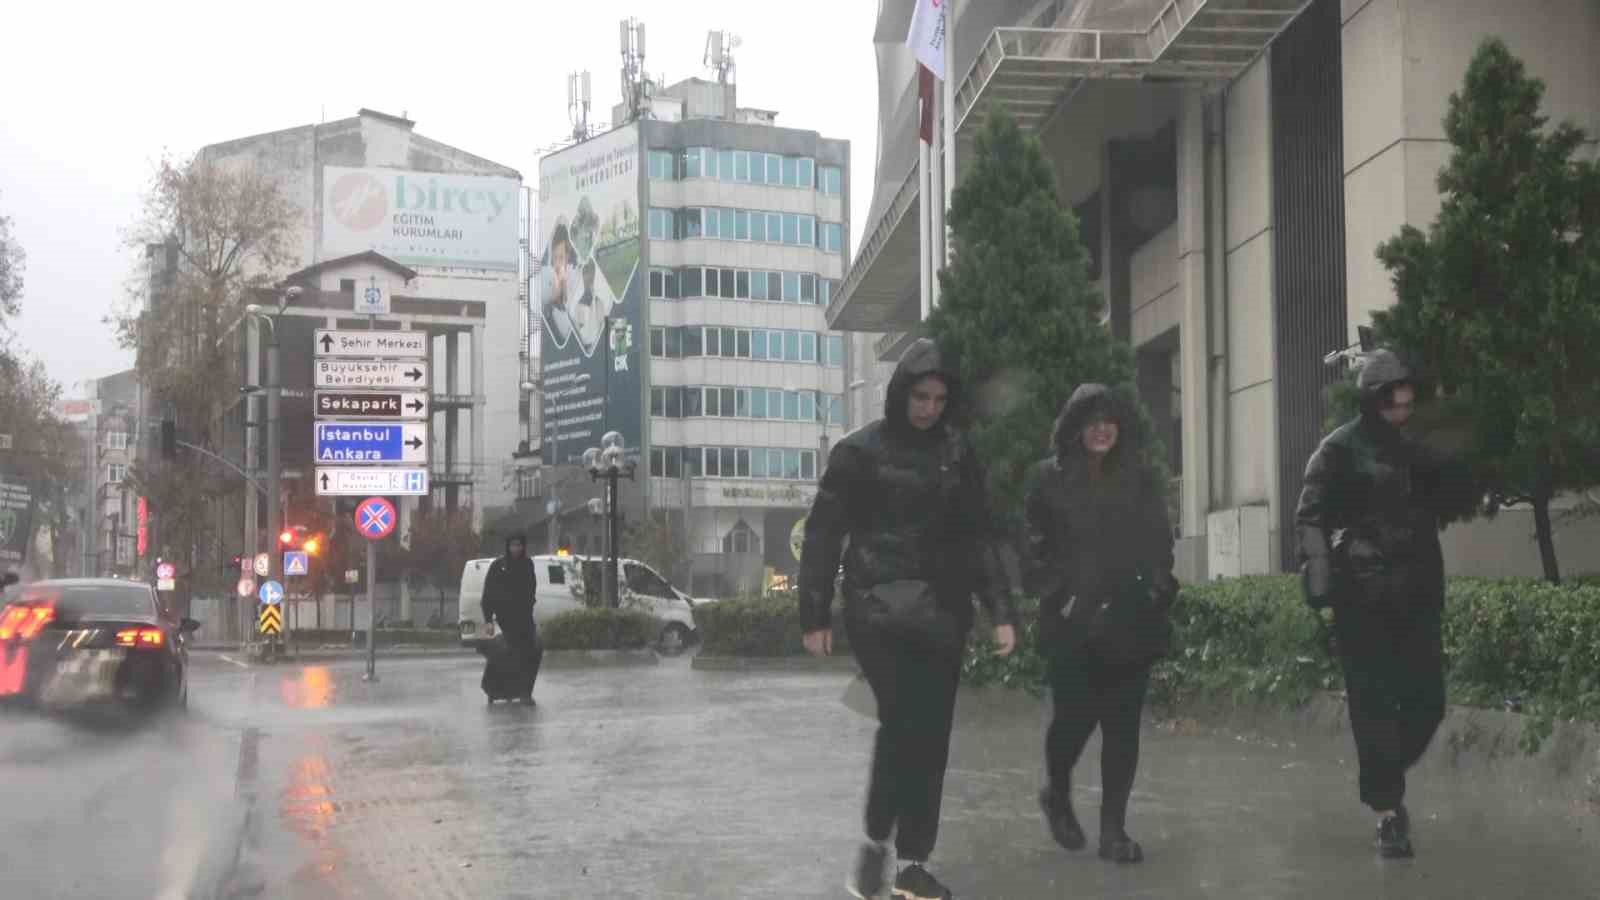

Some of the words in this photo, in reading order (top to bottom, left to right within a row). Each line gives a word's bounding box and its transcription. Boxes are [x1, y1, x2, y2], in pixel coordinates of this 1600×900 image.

[392, 226, 463, 240] KURUMLARI
[341, 337, 371, 348] Şehir
[377, 338, 422, 349] Merkezi
[325, 374, 395, 384] Belediyesi
[321, 396, 398, 414] Sekapark
[320, 424, 390, 441] İstanbul
[322, 447, 382, 460] Ankara
